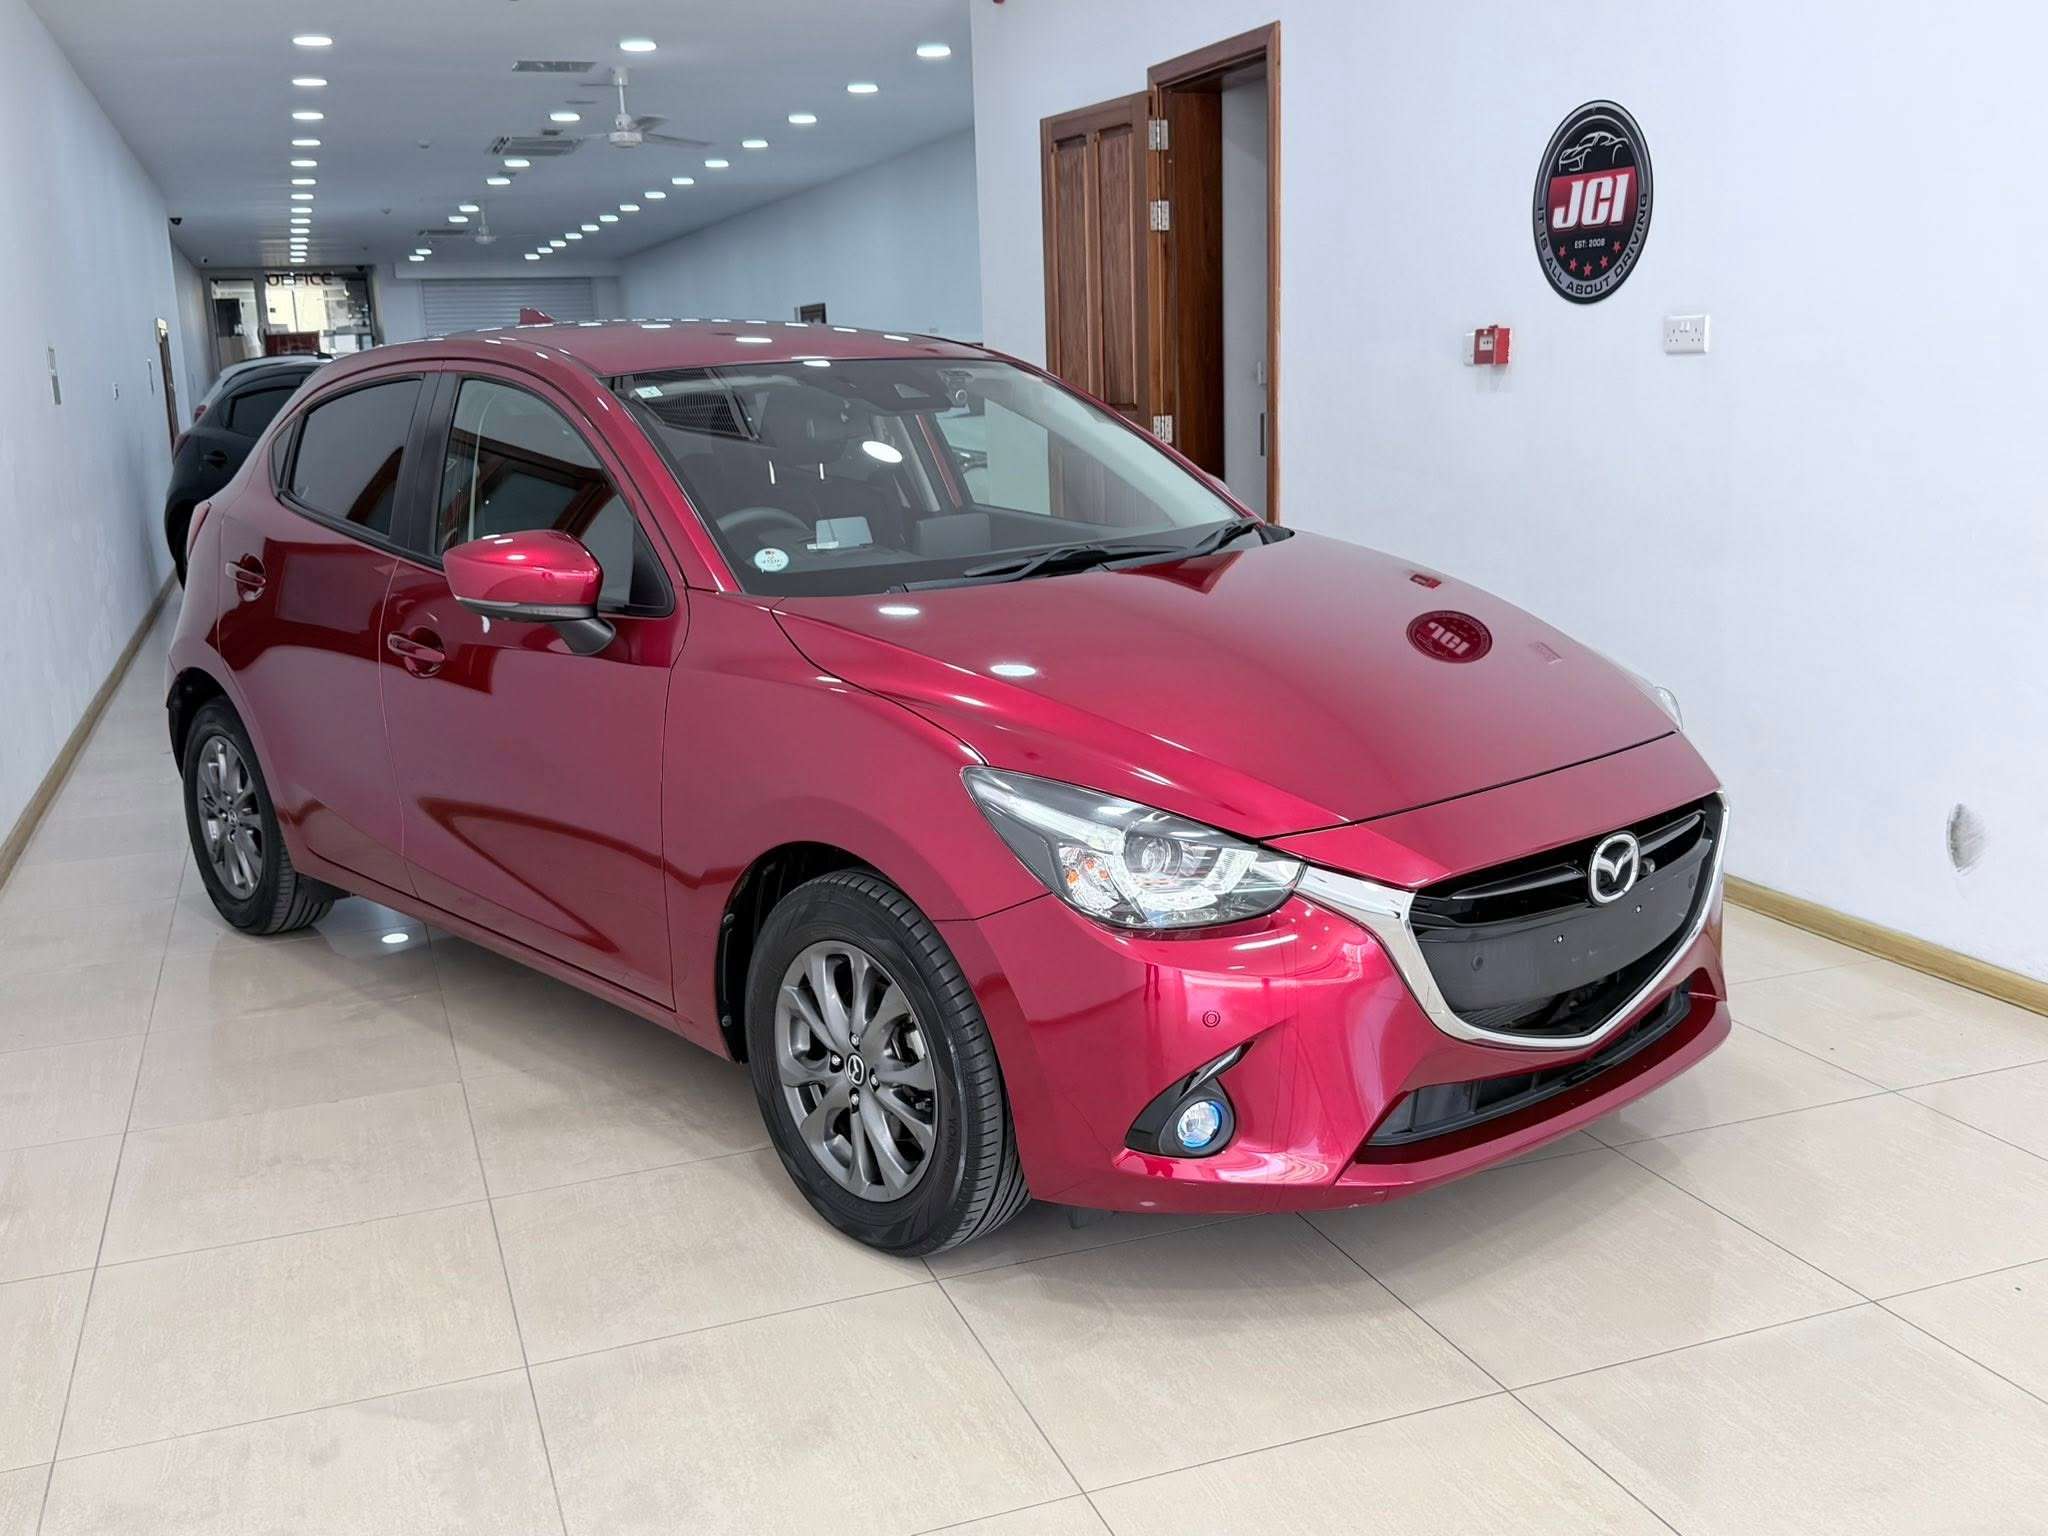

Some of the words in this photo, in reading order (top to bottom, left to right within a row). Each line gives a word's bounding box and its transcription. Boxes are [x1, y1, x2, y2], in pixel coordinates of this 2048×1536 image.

[1552, 173, 1629, 229] JCI
[1546, 257, 1563, 284] ALL
[1566, 276, 1611, 295] ABOUT
[1615, 193, 1648, 278] DRIVING
[266, 273, 332, 286] OFFICE
